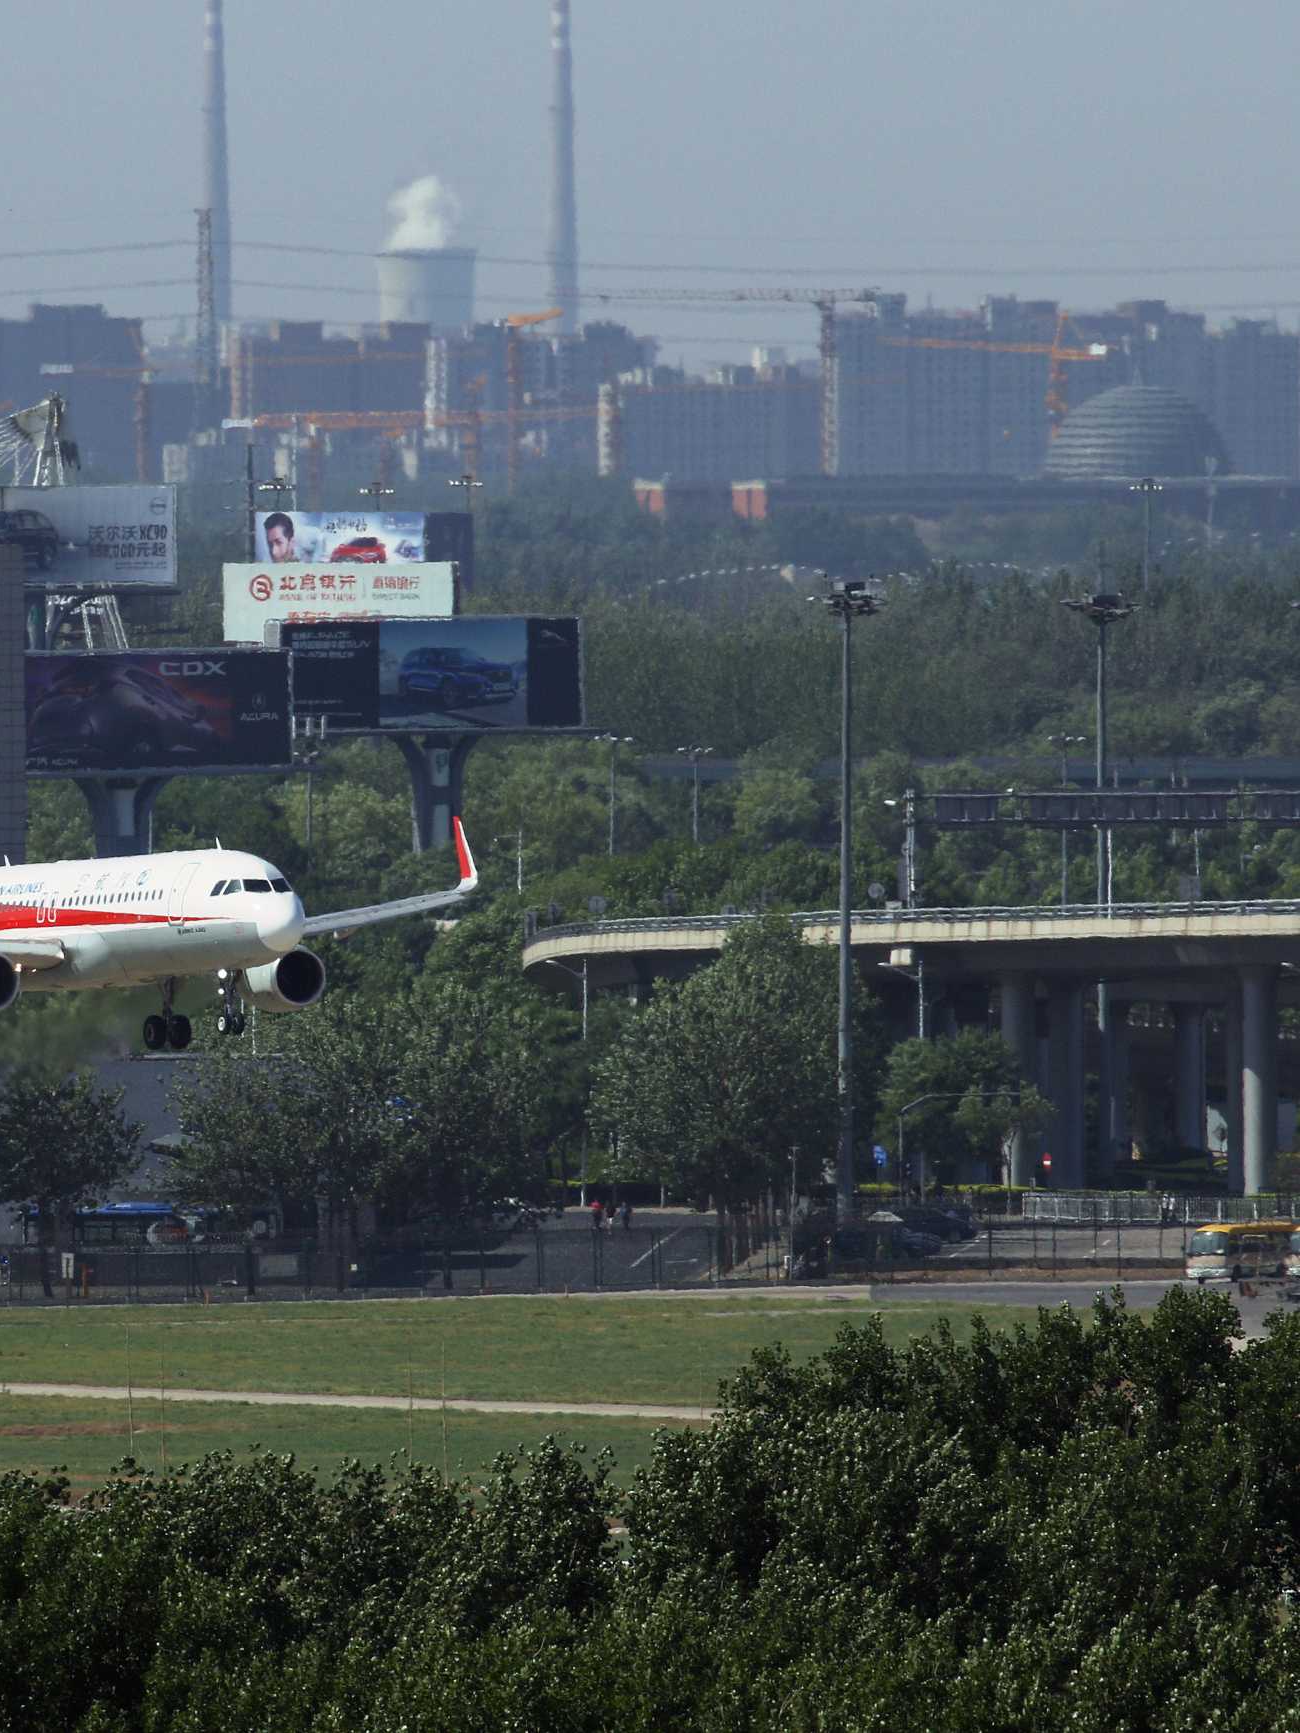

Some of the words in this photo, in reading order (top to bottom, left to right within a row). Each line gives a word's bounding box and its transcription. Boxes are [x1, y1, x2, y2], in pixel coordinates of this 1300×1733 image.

[278, 573, 357, 591] 北京银行
[158, 661, 227, 676] CDX
[240, 712, 279, 721] ACURA
